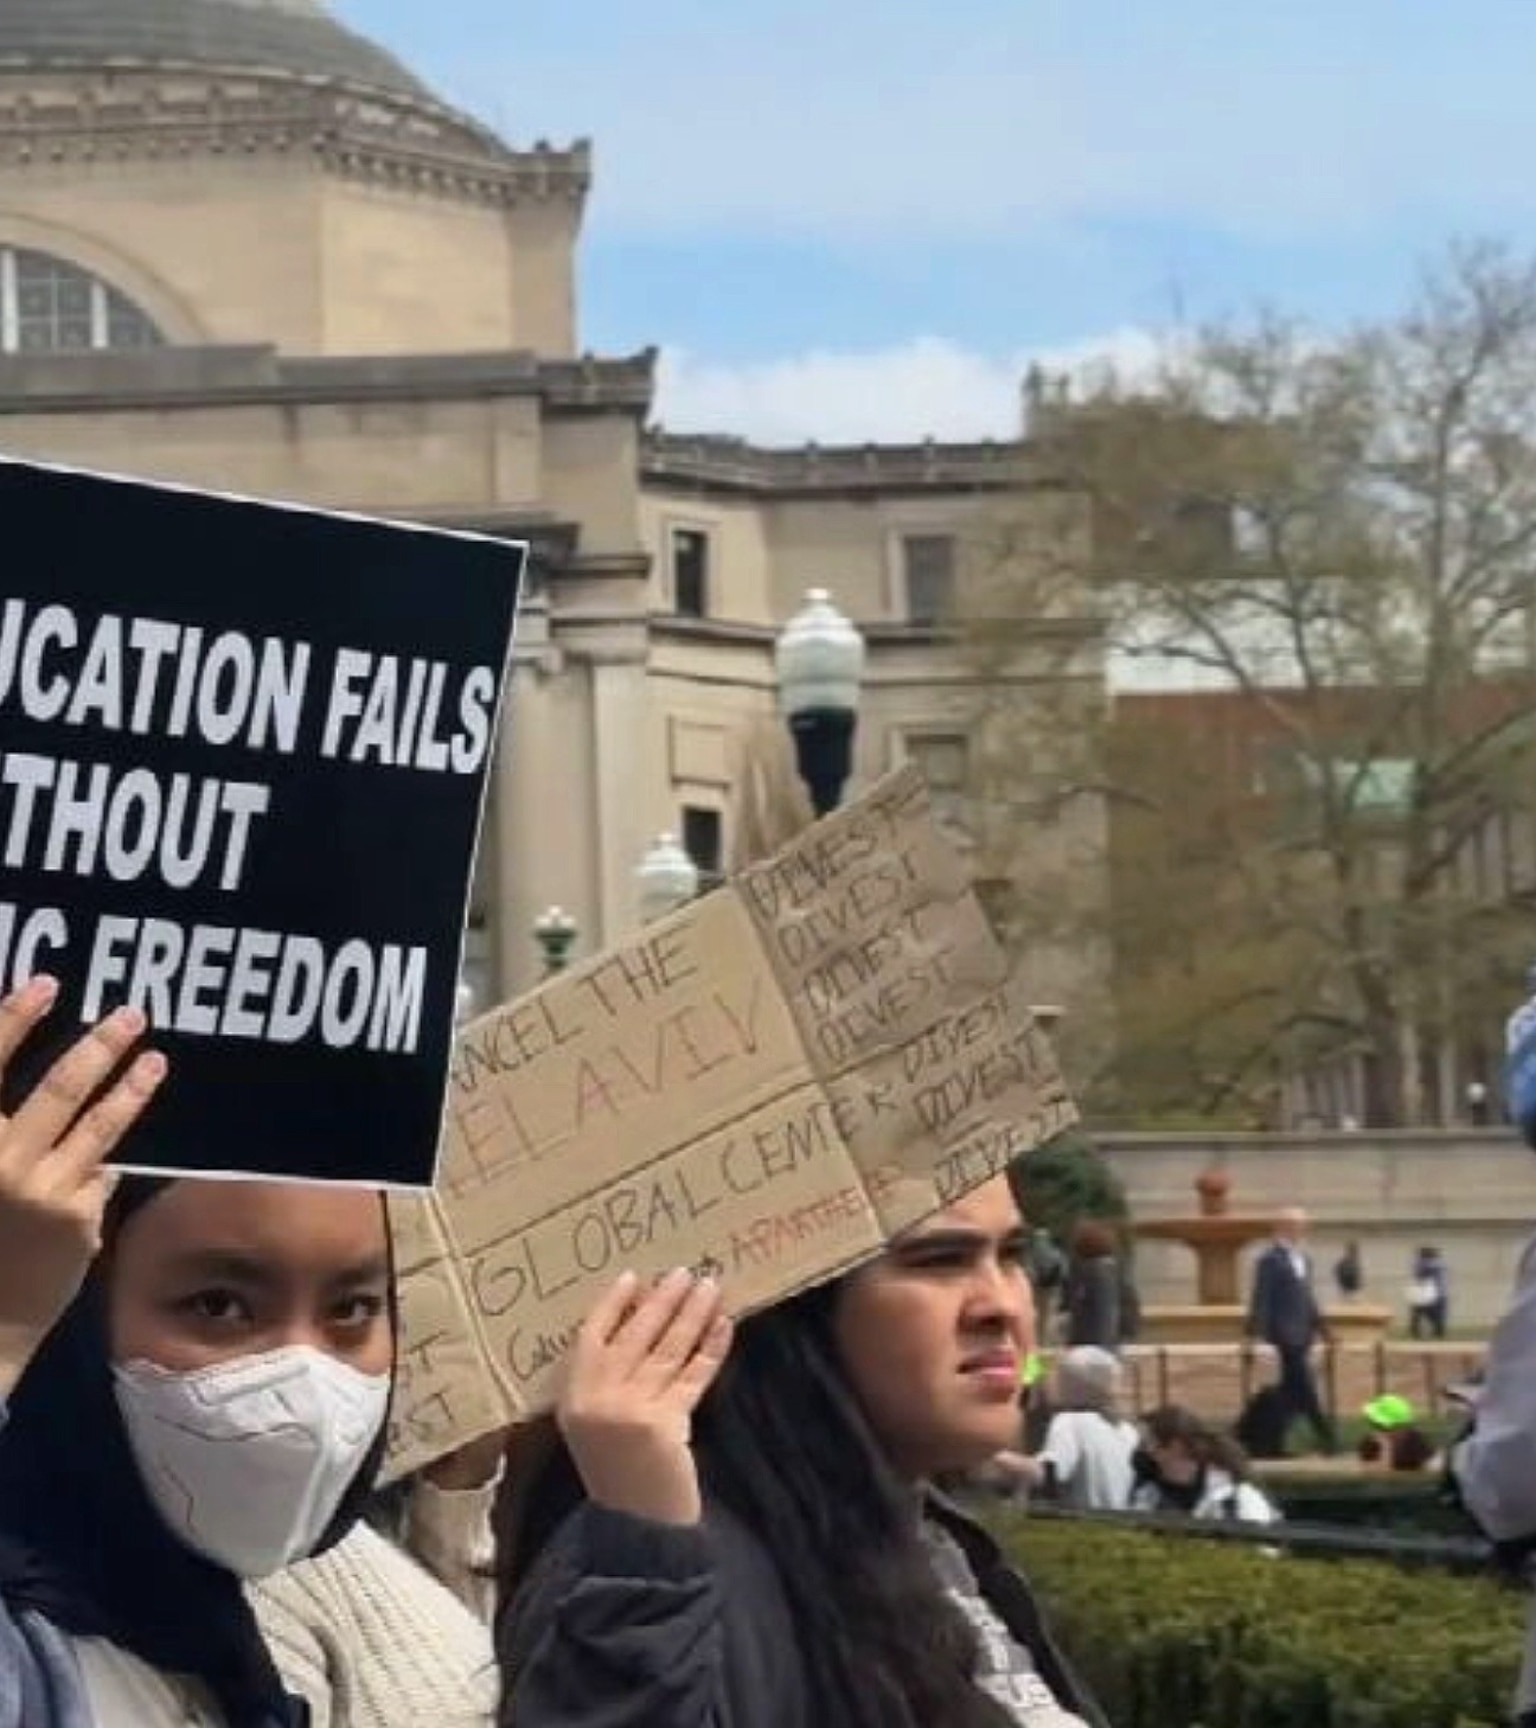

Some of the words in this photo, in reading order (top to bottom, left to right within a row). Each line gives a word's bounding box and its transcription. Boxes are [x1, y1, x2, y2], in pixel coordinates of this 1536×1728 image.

[321, 648, 494, 775] FAILS
[576, 922, 698, 1017] THE
[777, 845, 917, 968] DIVEST
[80, 916, 428, 1056] FREEDOM
[814, 948, 954, 1064] DIVEST
[574, 974, 764, 1130] AVIV
[470, 1160, 718, 1318] GLOBAL
[720, 1080, 899, 1194] CENTER
